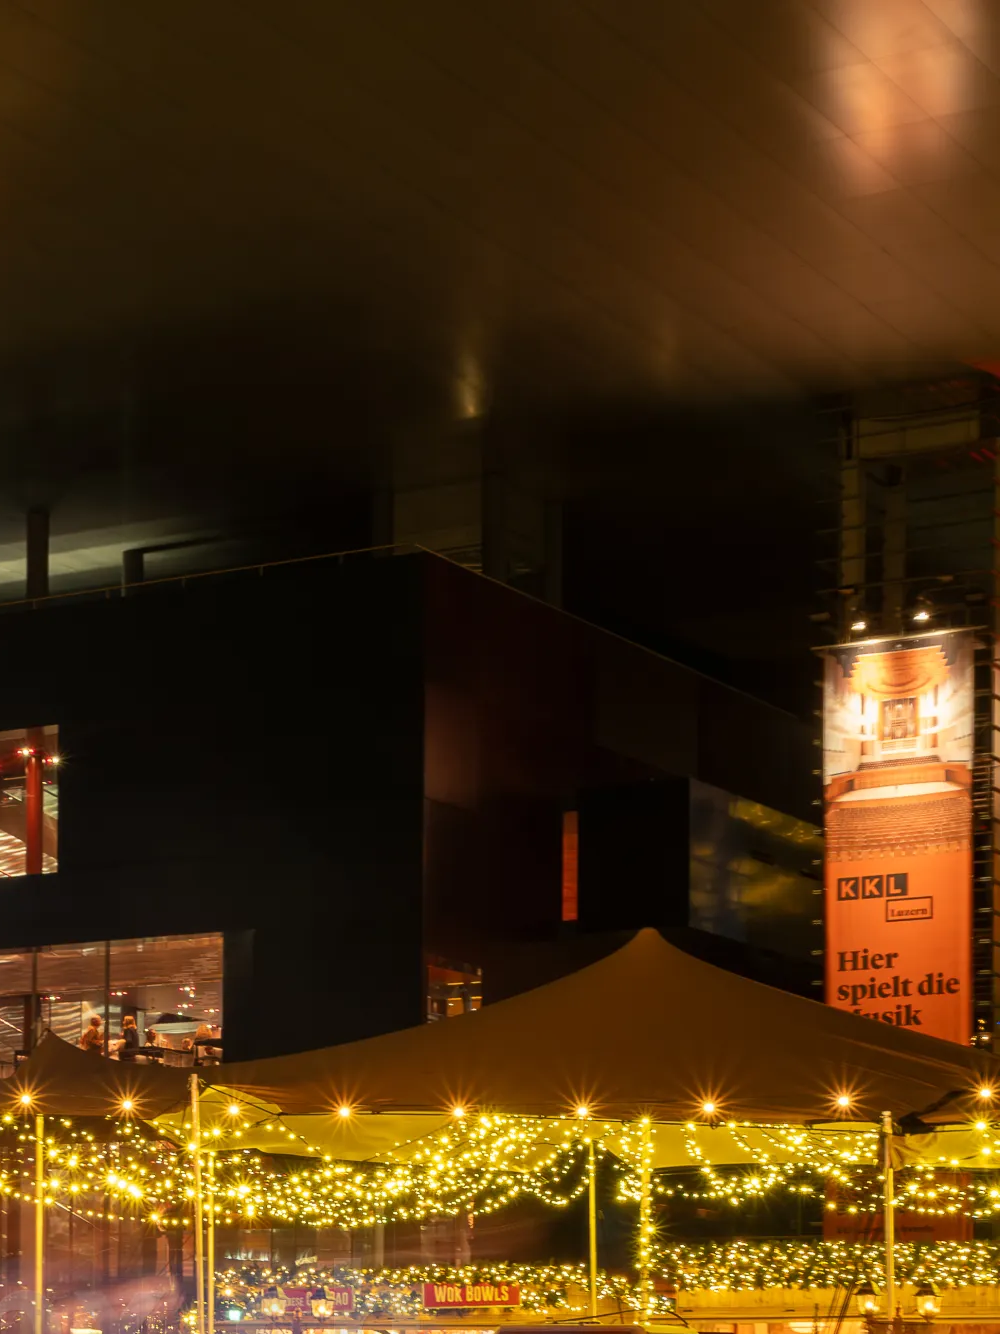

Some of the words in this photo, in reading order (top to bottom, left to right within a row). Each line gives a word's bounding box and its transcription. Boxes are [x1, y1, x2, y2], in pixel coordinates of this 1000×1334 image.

[840, 876, 902, 898] KKL
[890, 908, 928, 917] Luzern
[837, 948, 898, 972] Hier
[837, 976, 913, 1006] spielt
[918, 972, 960, 996] die
[853, 1004, 922, 1026] sik
[434, 1285, 462, 1303] WOK
[466, 1285, 509, 1302] BOWLS
